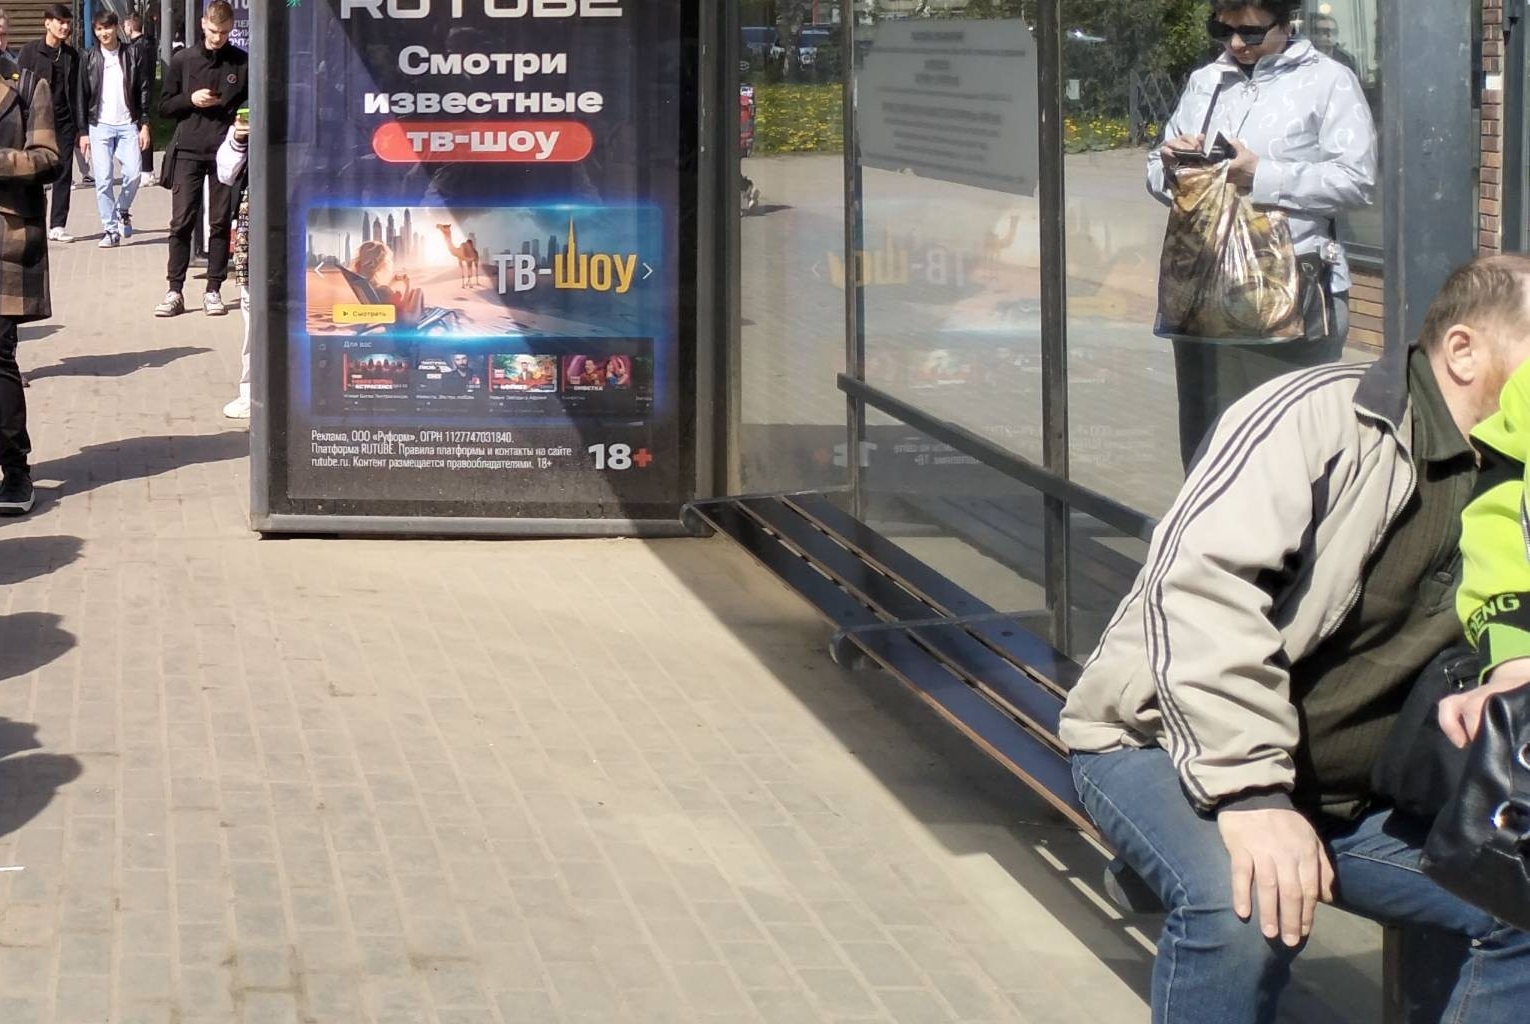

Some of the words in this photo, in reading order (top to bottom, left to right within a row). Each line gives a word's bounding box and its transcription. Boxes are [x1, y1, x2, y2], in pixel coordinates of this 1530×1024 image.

[398, 45, 567, 82] Смотри
[364, 91, 603, 114] известные
[406, 130, 560, 160] тв-шоу
[493, 234, 637, 295] ТВ-ШОУ
[311, 429, 349, 442] Реклама,
[351, 430, 370, 442] ООО
[420, 431, 443, 442] ОГРН
[311, 443, 359, 455] Платформа
[361, 443, 396, 454] RUTUBE.
[398, 443, 435, 456] Правила
[436, 444, 485, 457] платформы
[494, 447, 534, 455] контакты
[535, 447, 546, 455] на
[547, 445, 572, 455] сайте
[588, 443, 652, 470] 18+
[311, 456, 351, 467] rutube.ru.
[353, 457, 387, 467] Контент
[389, 459, 445, 469] размещается
[446, 457, 534, 470] правообладателями.
[537, 457, 552, 468] 18+
